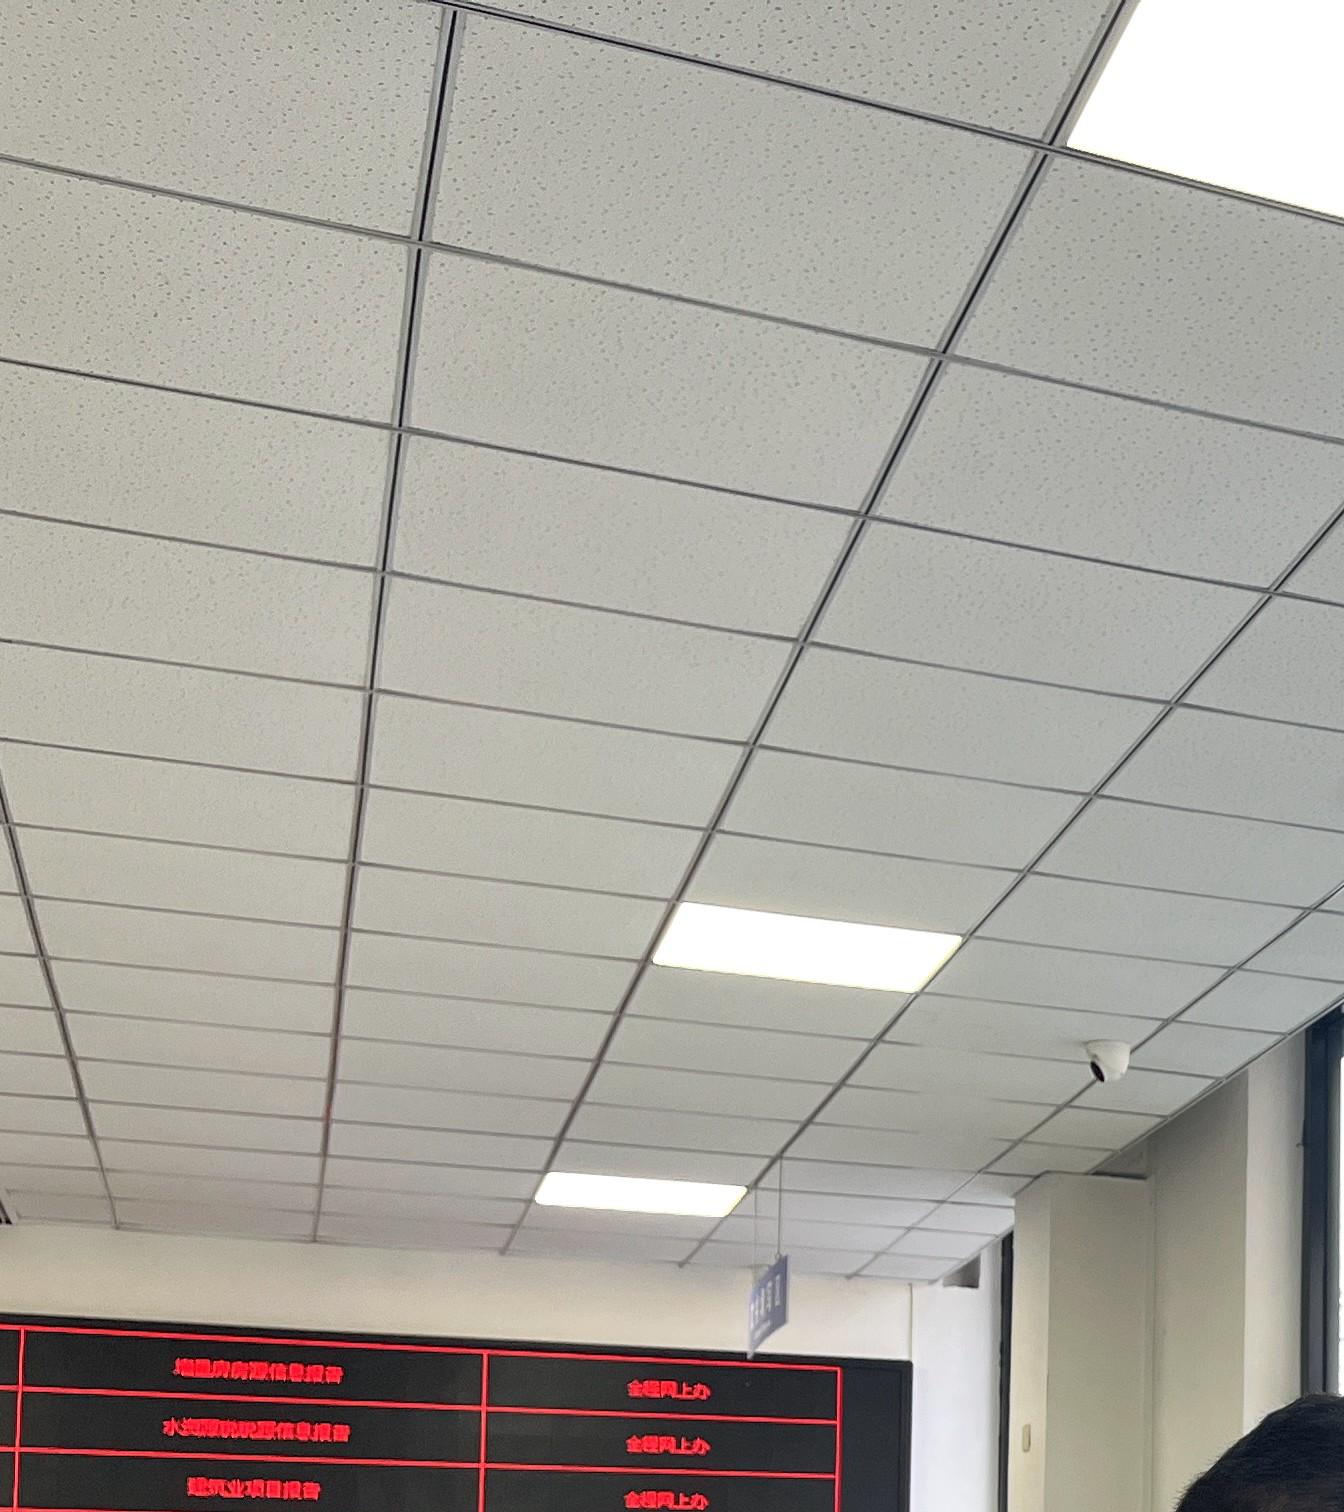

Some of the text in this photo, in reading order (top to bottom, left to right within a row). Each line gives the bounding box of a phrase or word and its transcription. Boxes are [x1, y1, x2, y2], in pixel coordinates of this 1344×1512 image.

[186, 1476, 321, 1501] 建筑业项目报告
